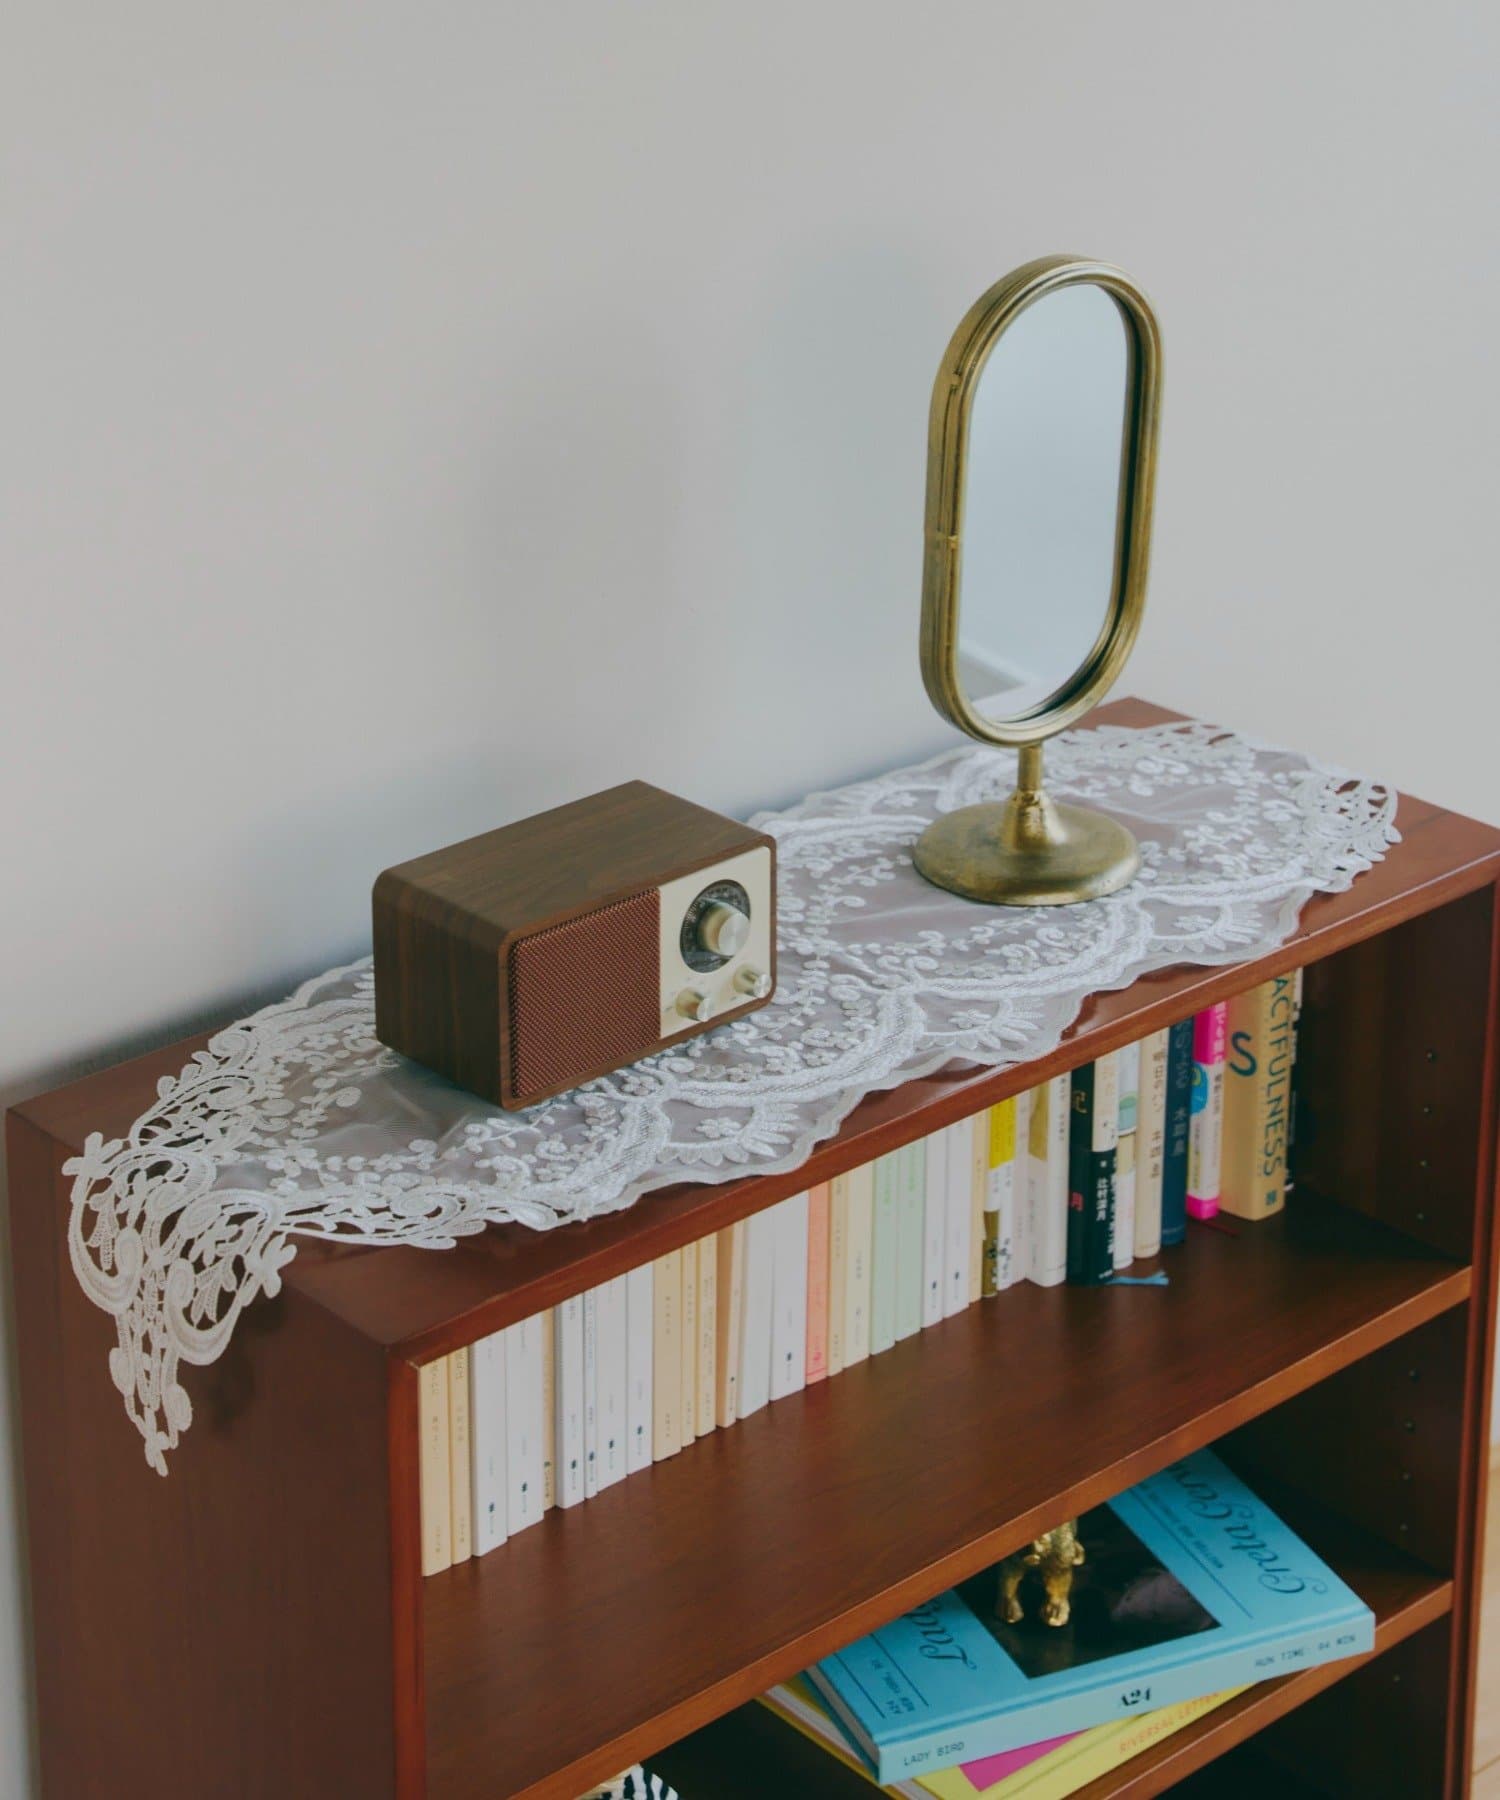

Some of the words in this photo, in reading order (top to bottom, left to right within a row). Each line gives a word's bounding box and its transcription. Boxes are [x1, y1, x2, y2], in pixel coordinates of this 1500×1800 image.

[1229, 1032, 1257, 1077] S
[1263, 978, 1289, 1176] ACTFULNESS
[1224, 1524, 1328, 1595] Greta
[902, 1602, 978, 1671] Lad
[1119, 1687, 1151, 1706] A24
[903, 1750, 931, 1766] LADY
[936, 1741, 965, 1757] BIRD
